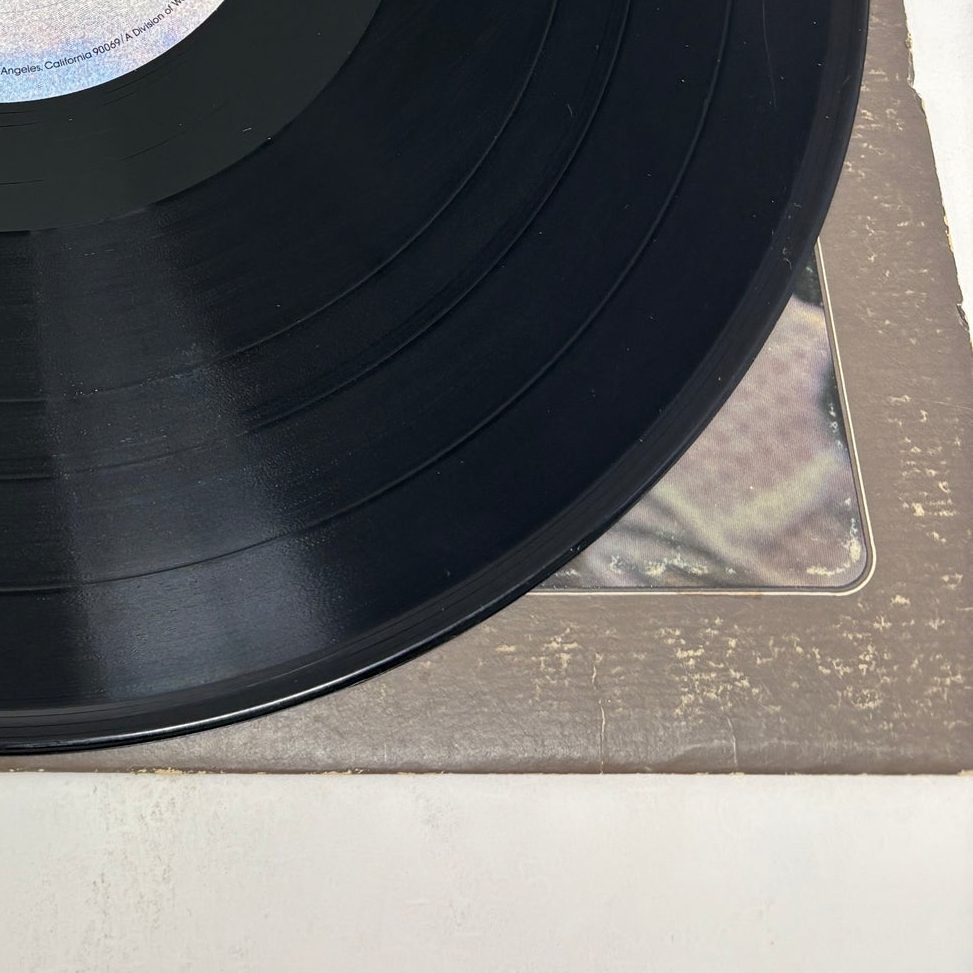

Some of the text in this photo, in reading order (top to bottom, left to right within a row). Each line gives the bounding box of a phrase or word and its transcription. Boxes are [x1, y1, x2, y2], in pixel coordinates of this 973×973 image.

[44, 52, 93, 70] California
[132, 14, 165, 37] Division
[165, 3, 173, 15] of
